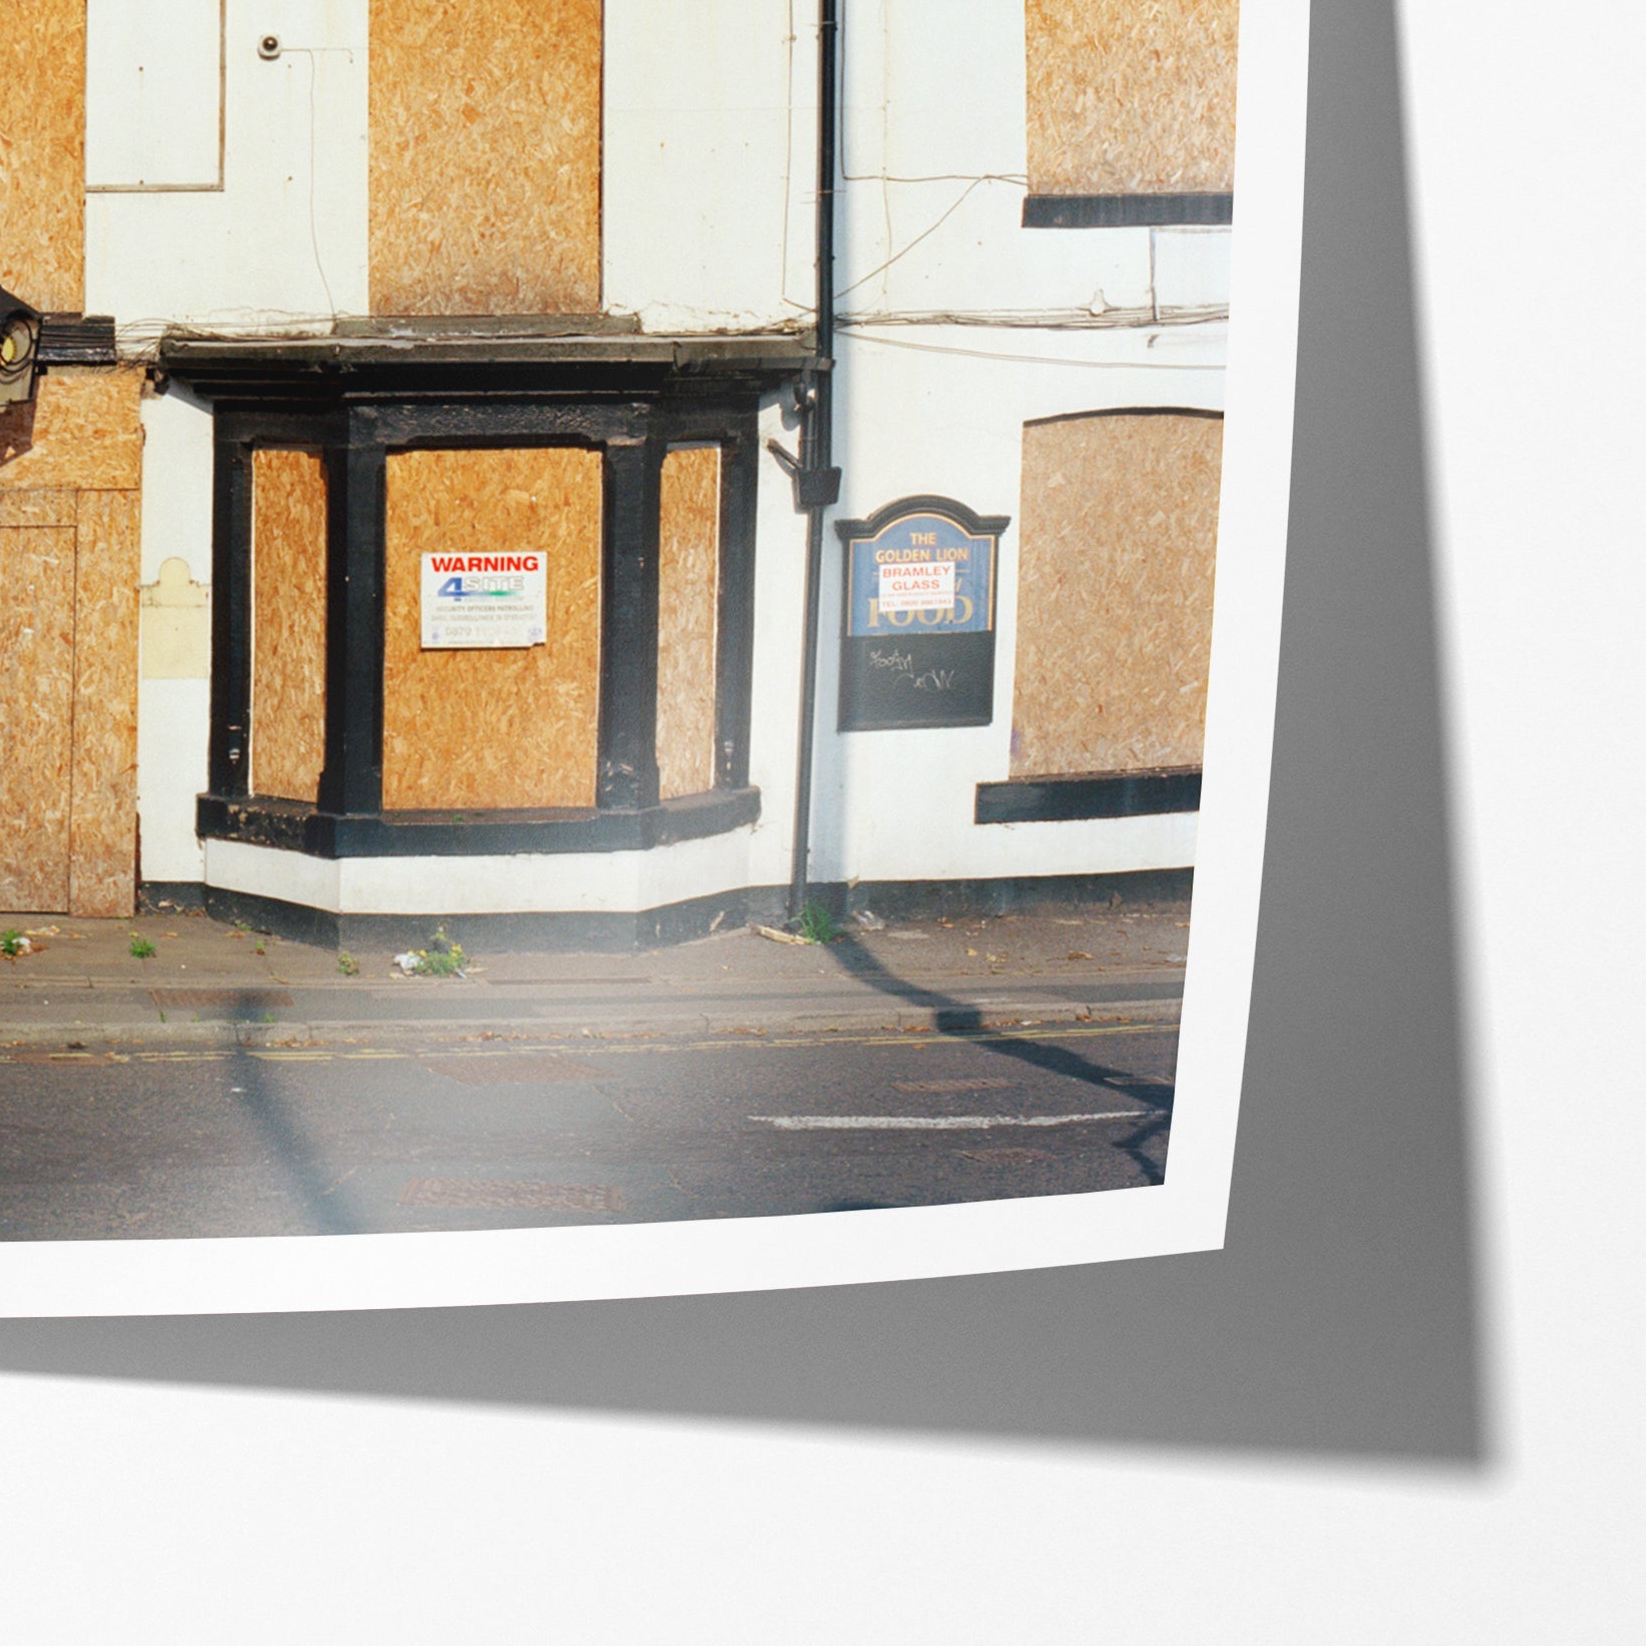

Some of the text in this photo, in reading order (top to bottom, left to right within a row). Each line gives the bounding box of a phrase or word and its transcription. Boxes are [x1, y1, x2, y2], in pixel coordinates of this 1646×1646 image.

[910, 532, 937, 545] THE
[875, 547, 970, 564] GOLDEN LION
[431, 556, 539, 572] WARNING
[883, 566, 951, 578] BRAMLEY
[892, 580, 941, 591] GLASS
